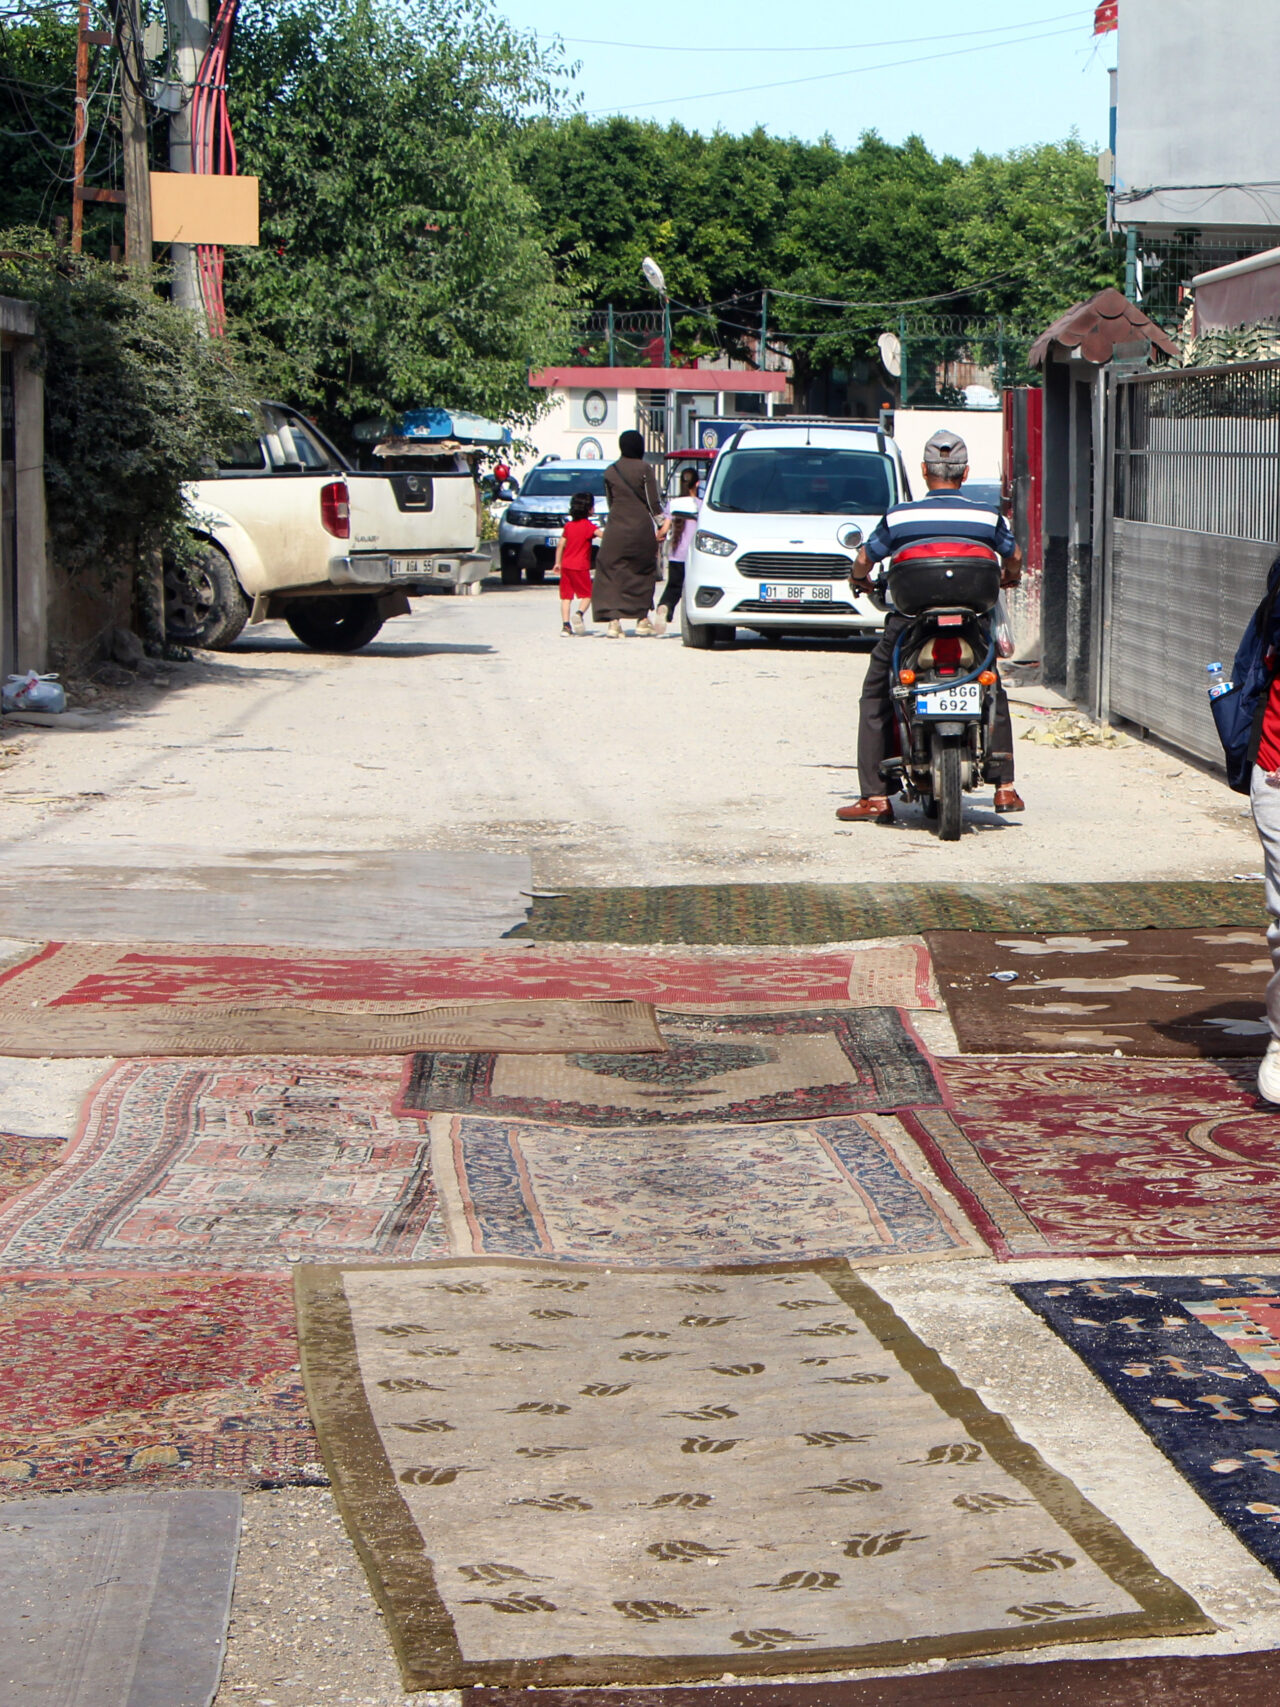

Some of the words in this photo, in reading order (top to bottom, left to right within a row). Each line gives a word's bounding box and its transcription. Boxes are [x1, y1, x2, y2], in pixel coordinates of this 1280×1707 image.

[766, 587, 777, 597] 01
[787, 587, 805, 598] BBF
[812, 588, 830, 599] 688
[949, 686, 977, 697] BGG
[940, 700, 968, 711] 692
